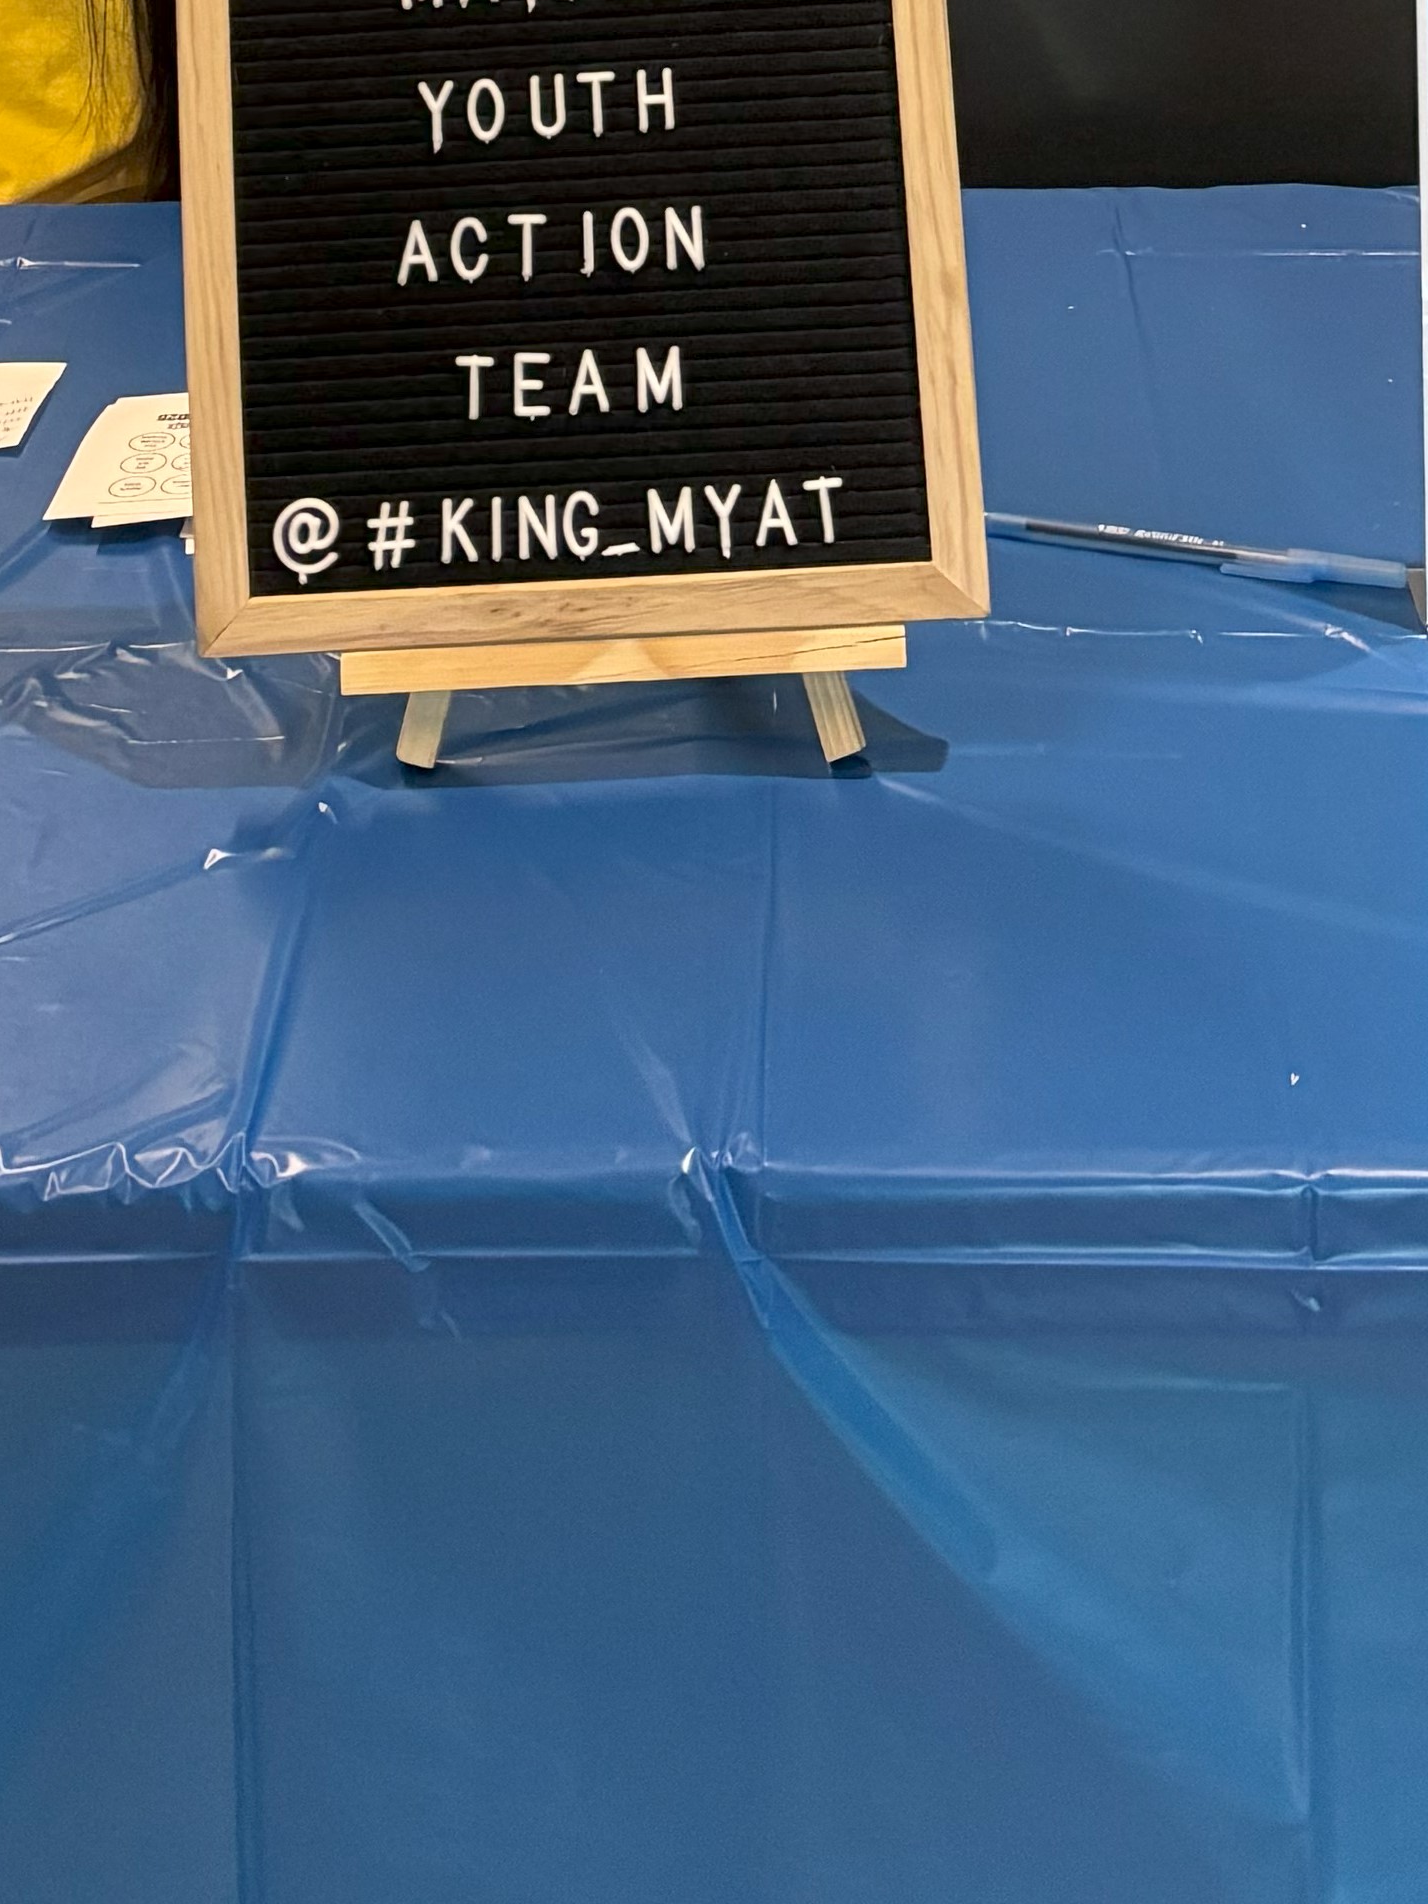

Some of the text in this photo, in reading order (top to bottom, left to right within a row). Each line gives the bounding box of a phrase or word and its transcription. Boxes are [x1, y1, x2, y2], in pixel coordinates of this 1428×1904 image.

[417, 67, 675, 154] YOUTH
[397, 205, 705, 286] ACTION
[455, 345, 683, 421] TEAM
